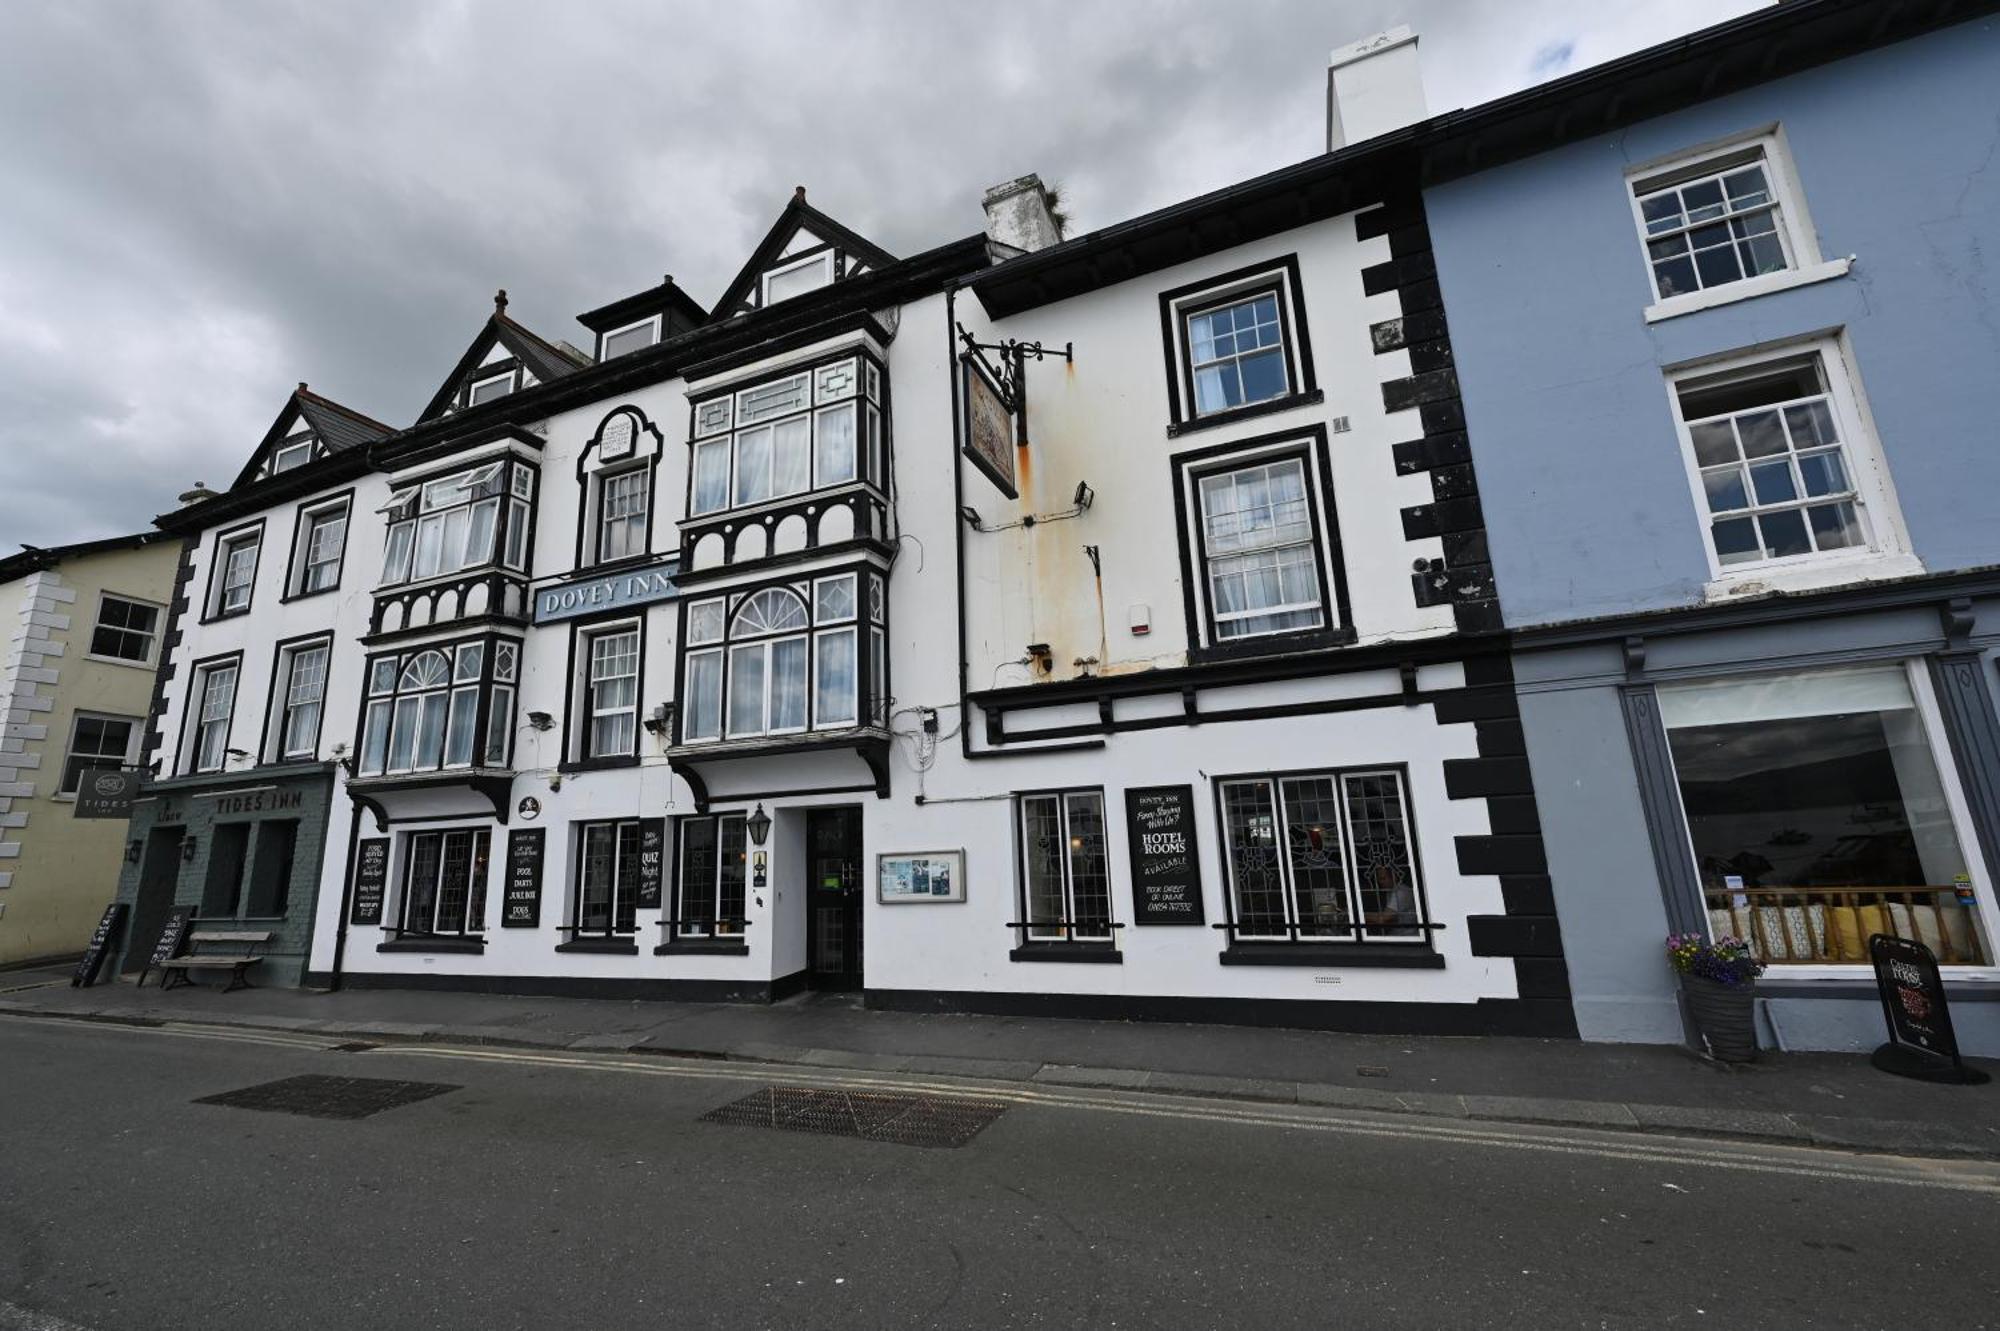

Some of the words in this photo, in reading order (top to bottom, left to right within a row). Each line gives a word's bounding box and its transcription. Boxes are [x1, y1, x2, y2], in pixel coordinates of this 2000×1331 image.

[545, 581, 618, 613] DOVEY
[626, 570, 672, 597] INN
[85, 799, 129, 808] TIDES
[217, 793, 263, 814] TIDES
[271, 791, 302, 810] INN
[1141, 832, 1186, 844] HOTEL
[1143, 843, 1186, 855] ROOMS
[642, 851, 659, 866] QUIZ
[517, 867, 532, 876] POOL
[1144, 857, 1187, 875] AVAILABLE
[514, 879, 533, 887] DARTS
